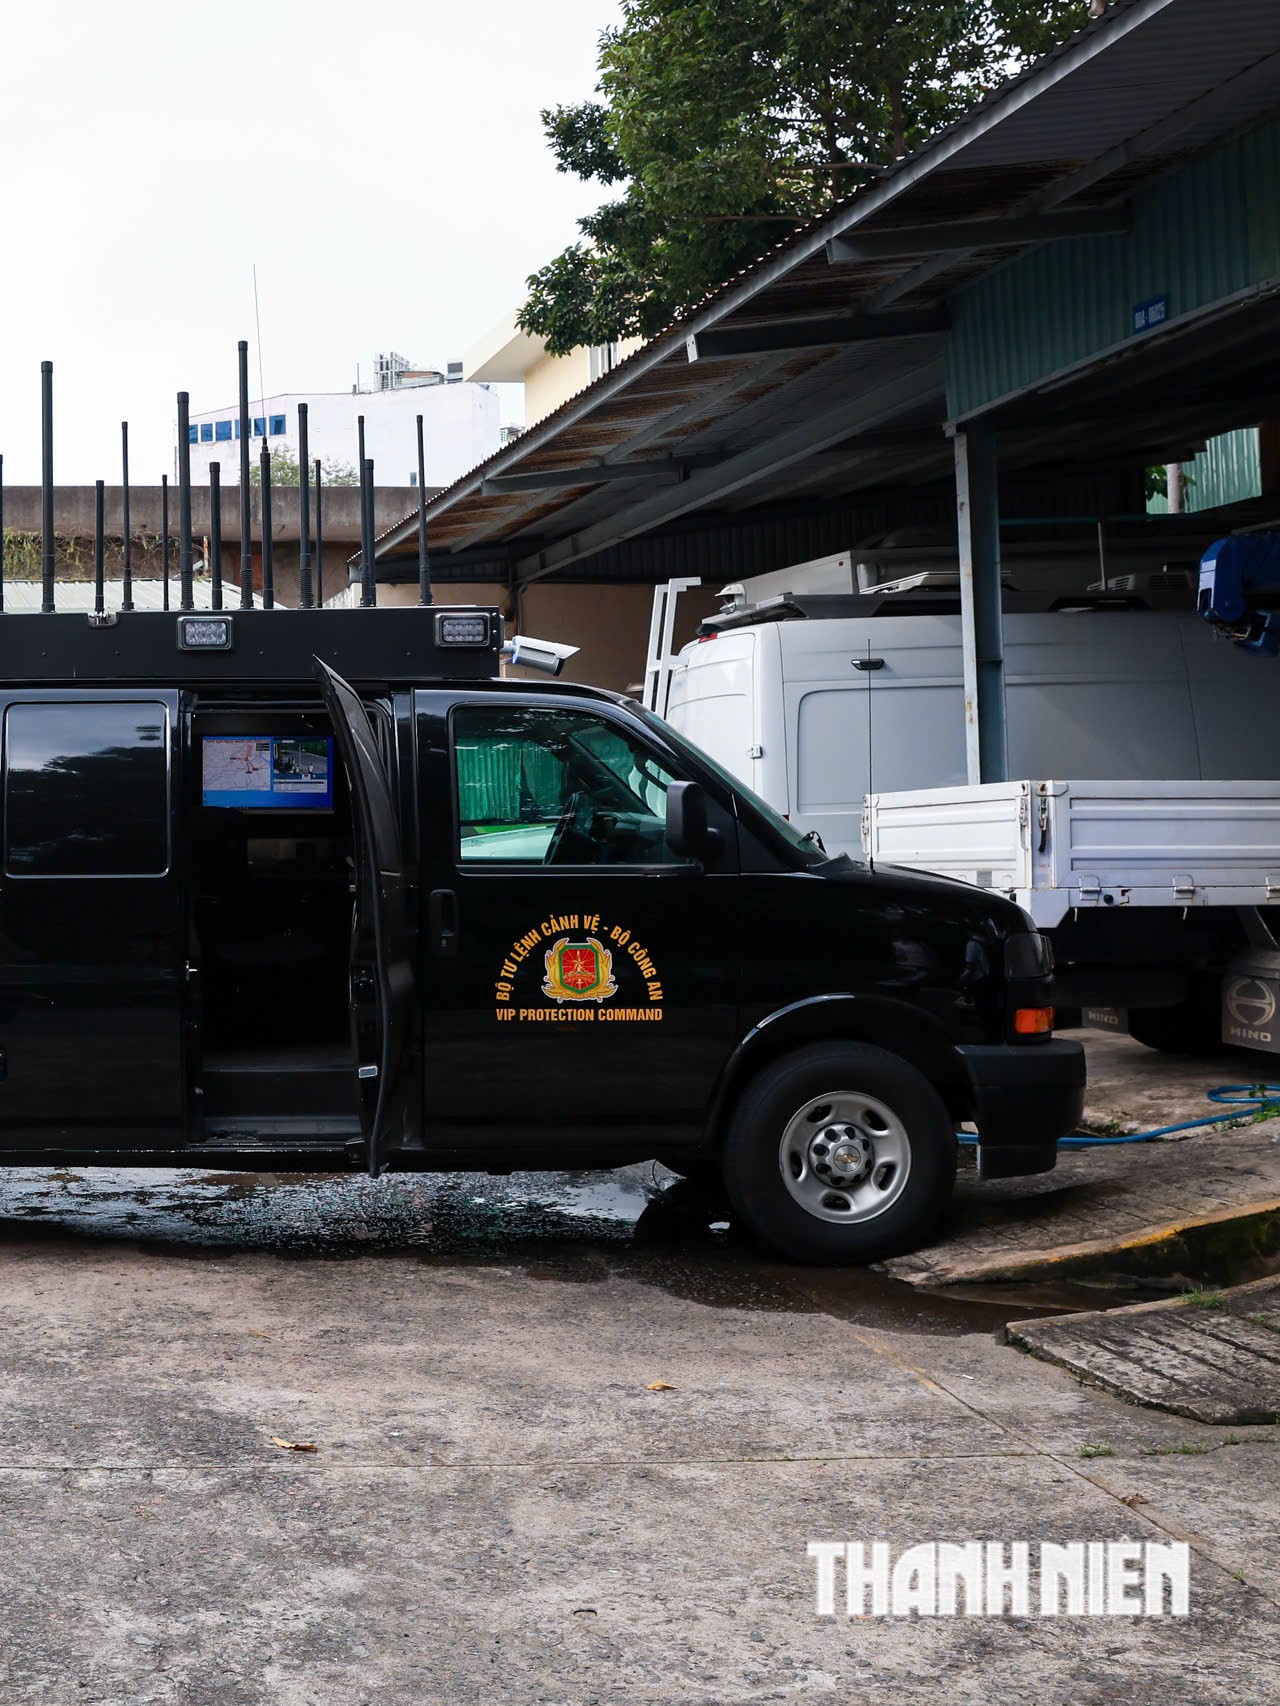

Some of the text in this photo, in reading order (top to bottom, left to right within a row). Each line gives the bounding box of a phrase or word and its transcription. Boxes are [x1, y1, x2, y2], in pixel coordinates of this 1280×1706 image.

[540, 914, 579, 936] CẢNH
[583, 914, 601, 934] VỆ
[510, 928, 542, 963] LỆNH
[609, 925, 631, 947] BỘ
[500, 958, 518, 979] TƯ
[627, 941, 657, 979] CÔNG
[496, 981, 515, 1001] BỘ
[647, 980, 664, 1001] AN
[496, 1008, 663, 1021] VIP PROTECTION COMMAND
[1088, 1010, 1119, 1025] HINO
[1230, 1026, 1272, 1042] HINO
